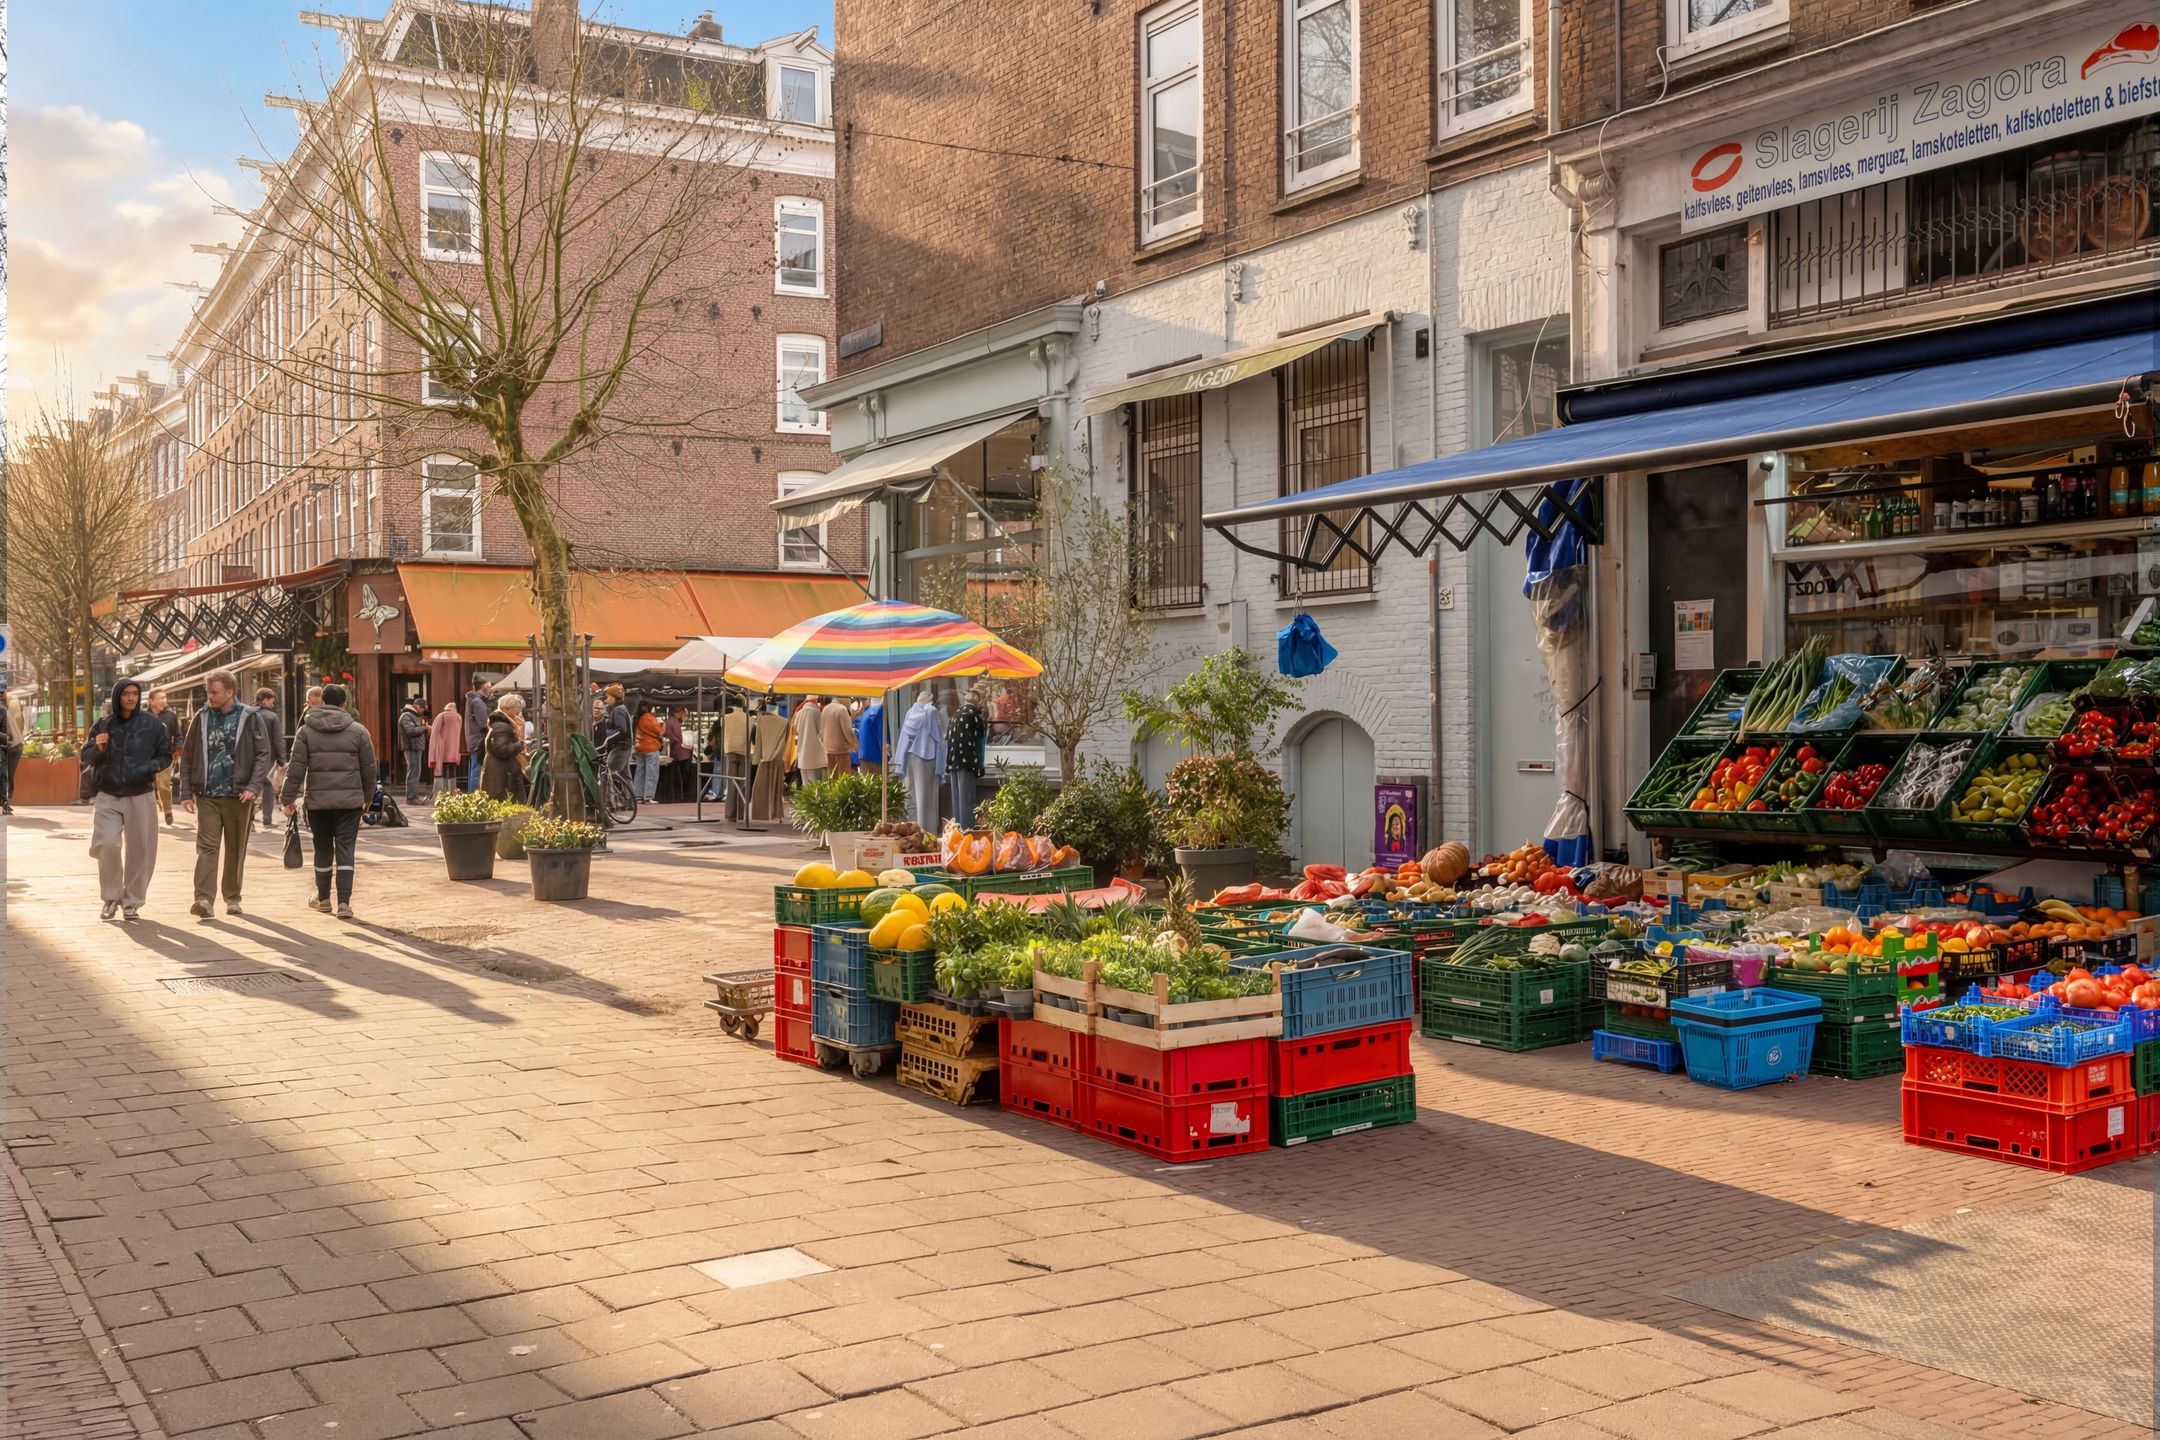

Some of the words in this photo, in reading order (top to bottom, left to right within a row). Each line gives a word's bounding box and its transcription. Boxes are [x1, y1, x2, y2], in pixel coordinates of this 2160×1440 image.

[1684, 194, 1734, 221] kalfsvlees,
[1737, 178, 1796, 210] geitenvlees,
[1799, 162, 1854, 189] lamsvlees,
[1857, 147, 1909, 175] merguez,
[1912, 122, 2002, 161] lamskoteletten,
[2005, 96, 2100, 136] kalfskoteletten
[2104, 86, 2114, 110] &
[1755, 93, 1899, 168] Slagerij
[1913, 55, 2067, 125] Zagora
